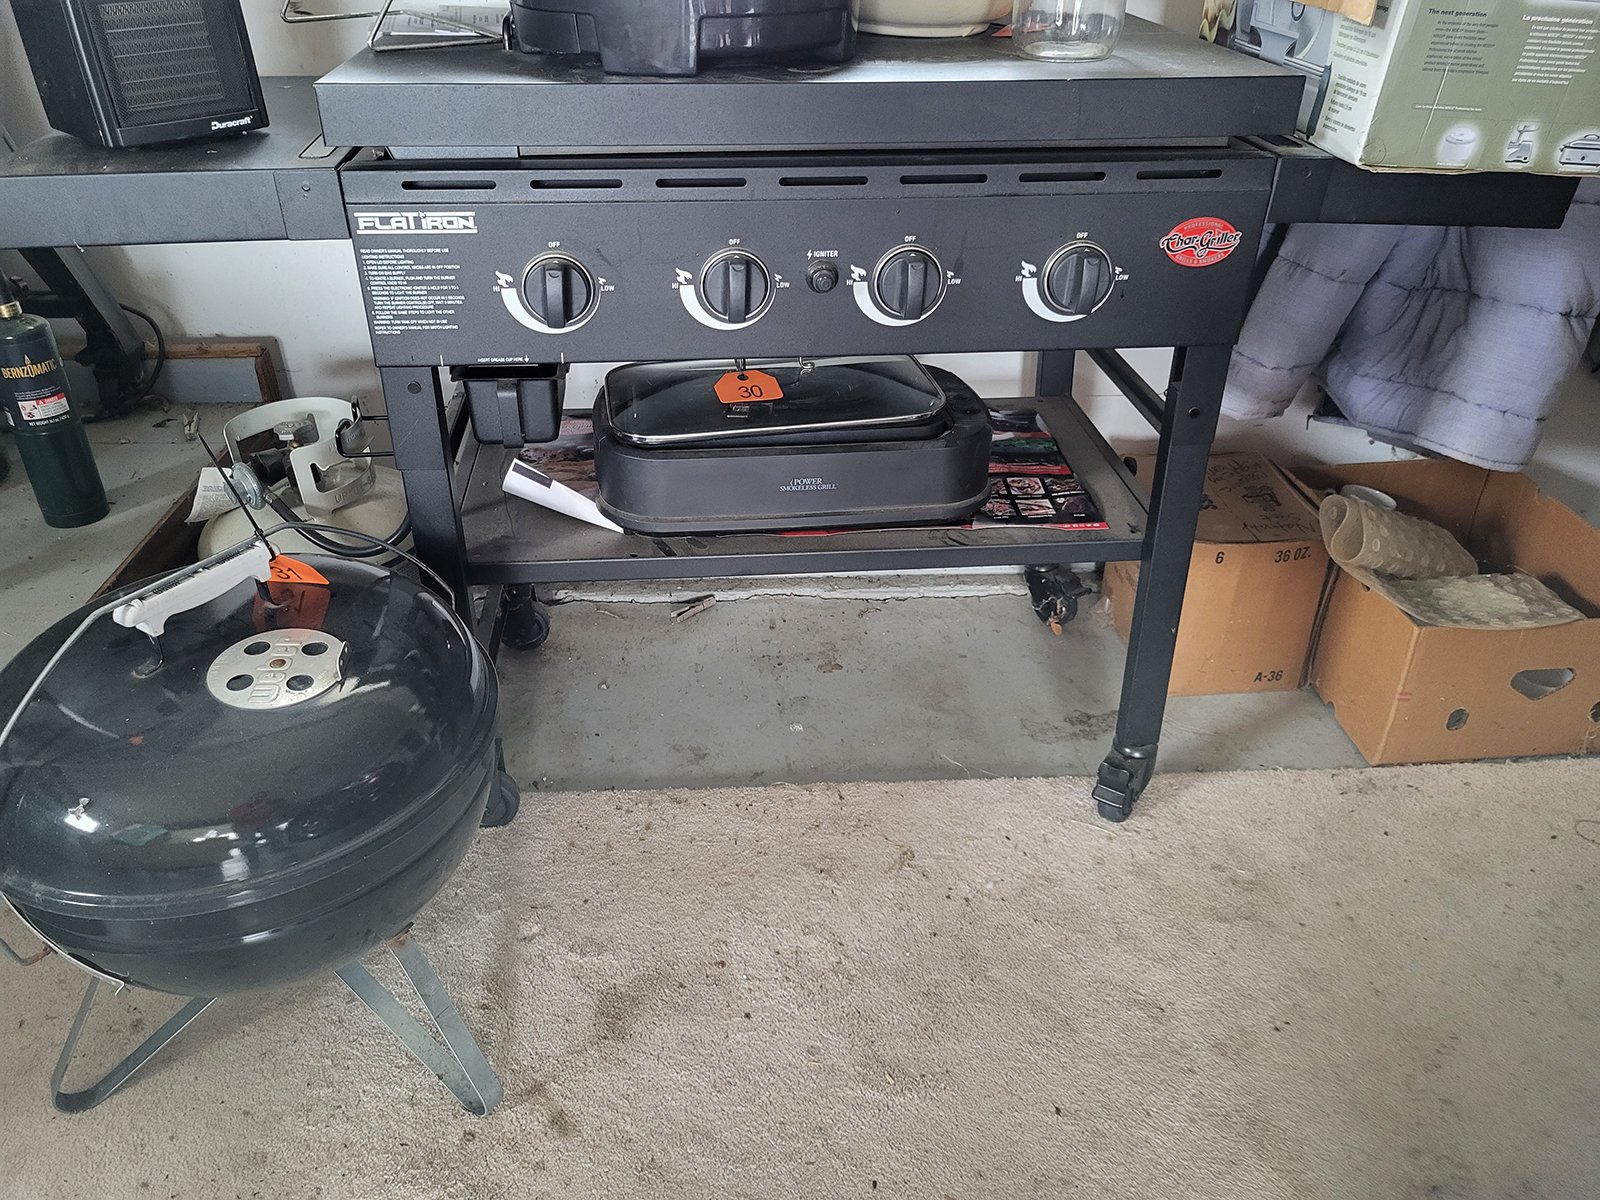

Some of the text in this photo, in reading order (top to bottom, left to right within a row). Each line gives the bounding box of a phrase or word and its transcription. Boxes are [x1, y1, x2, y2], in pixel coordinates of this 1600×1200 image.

[211, 117, 252, 130] Duracraft
[1160, 231, 1242, 258] Char-Griller
[1, 359, 58, 379] BERNZOMATIC
[738, 384, 763, 399] 30
[1215, 552, 1225, 564] 6
[1275, 546, 1311, 563] 36 OZ.
[1254, 670, 1283, 682] A-36
